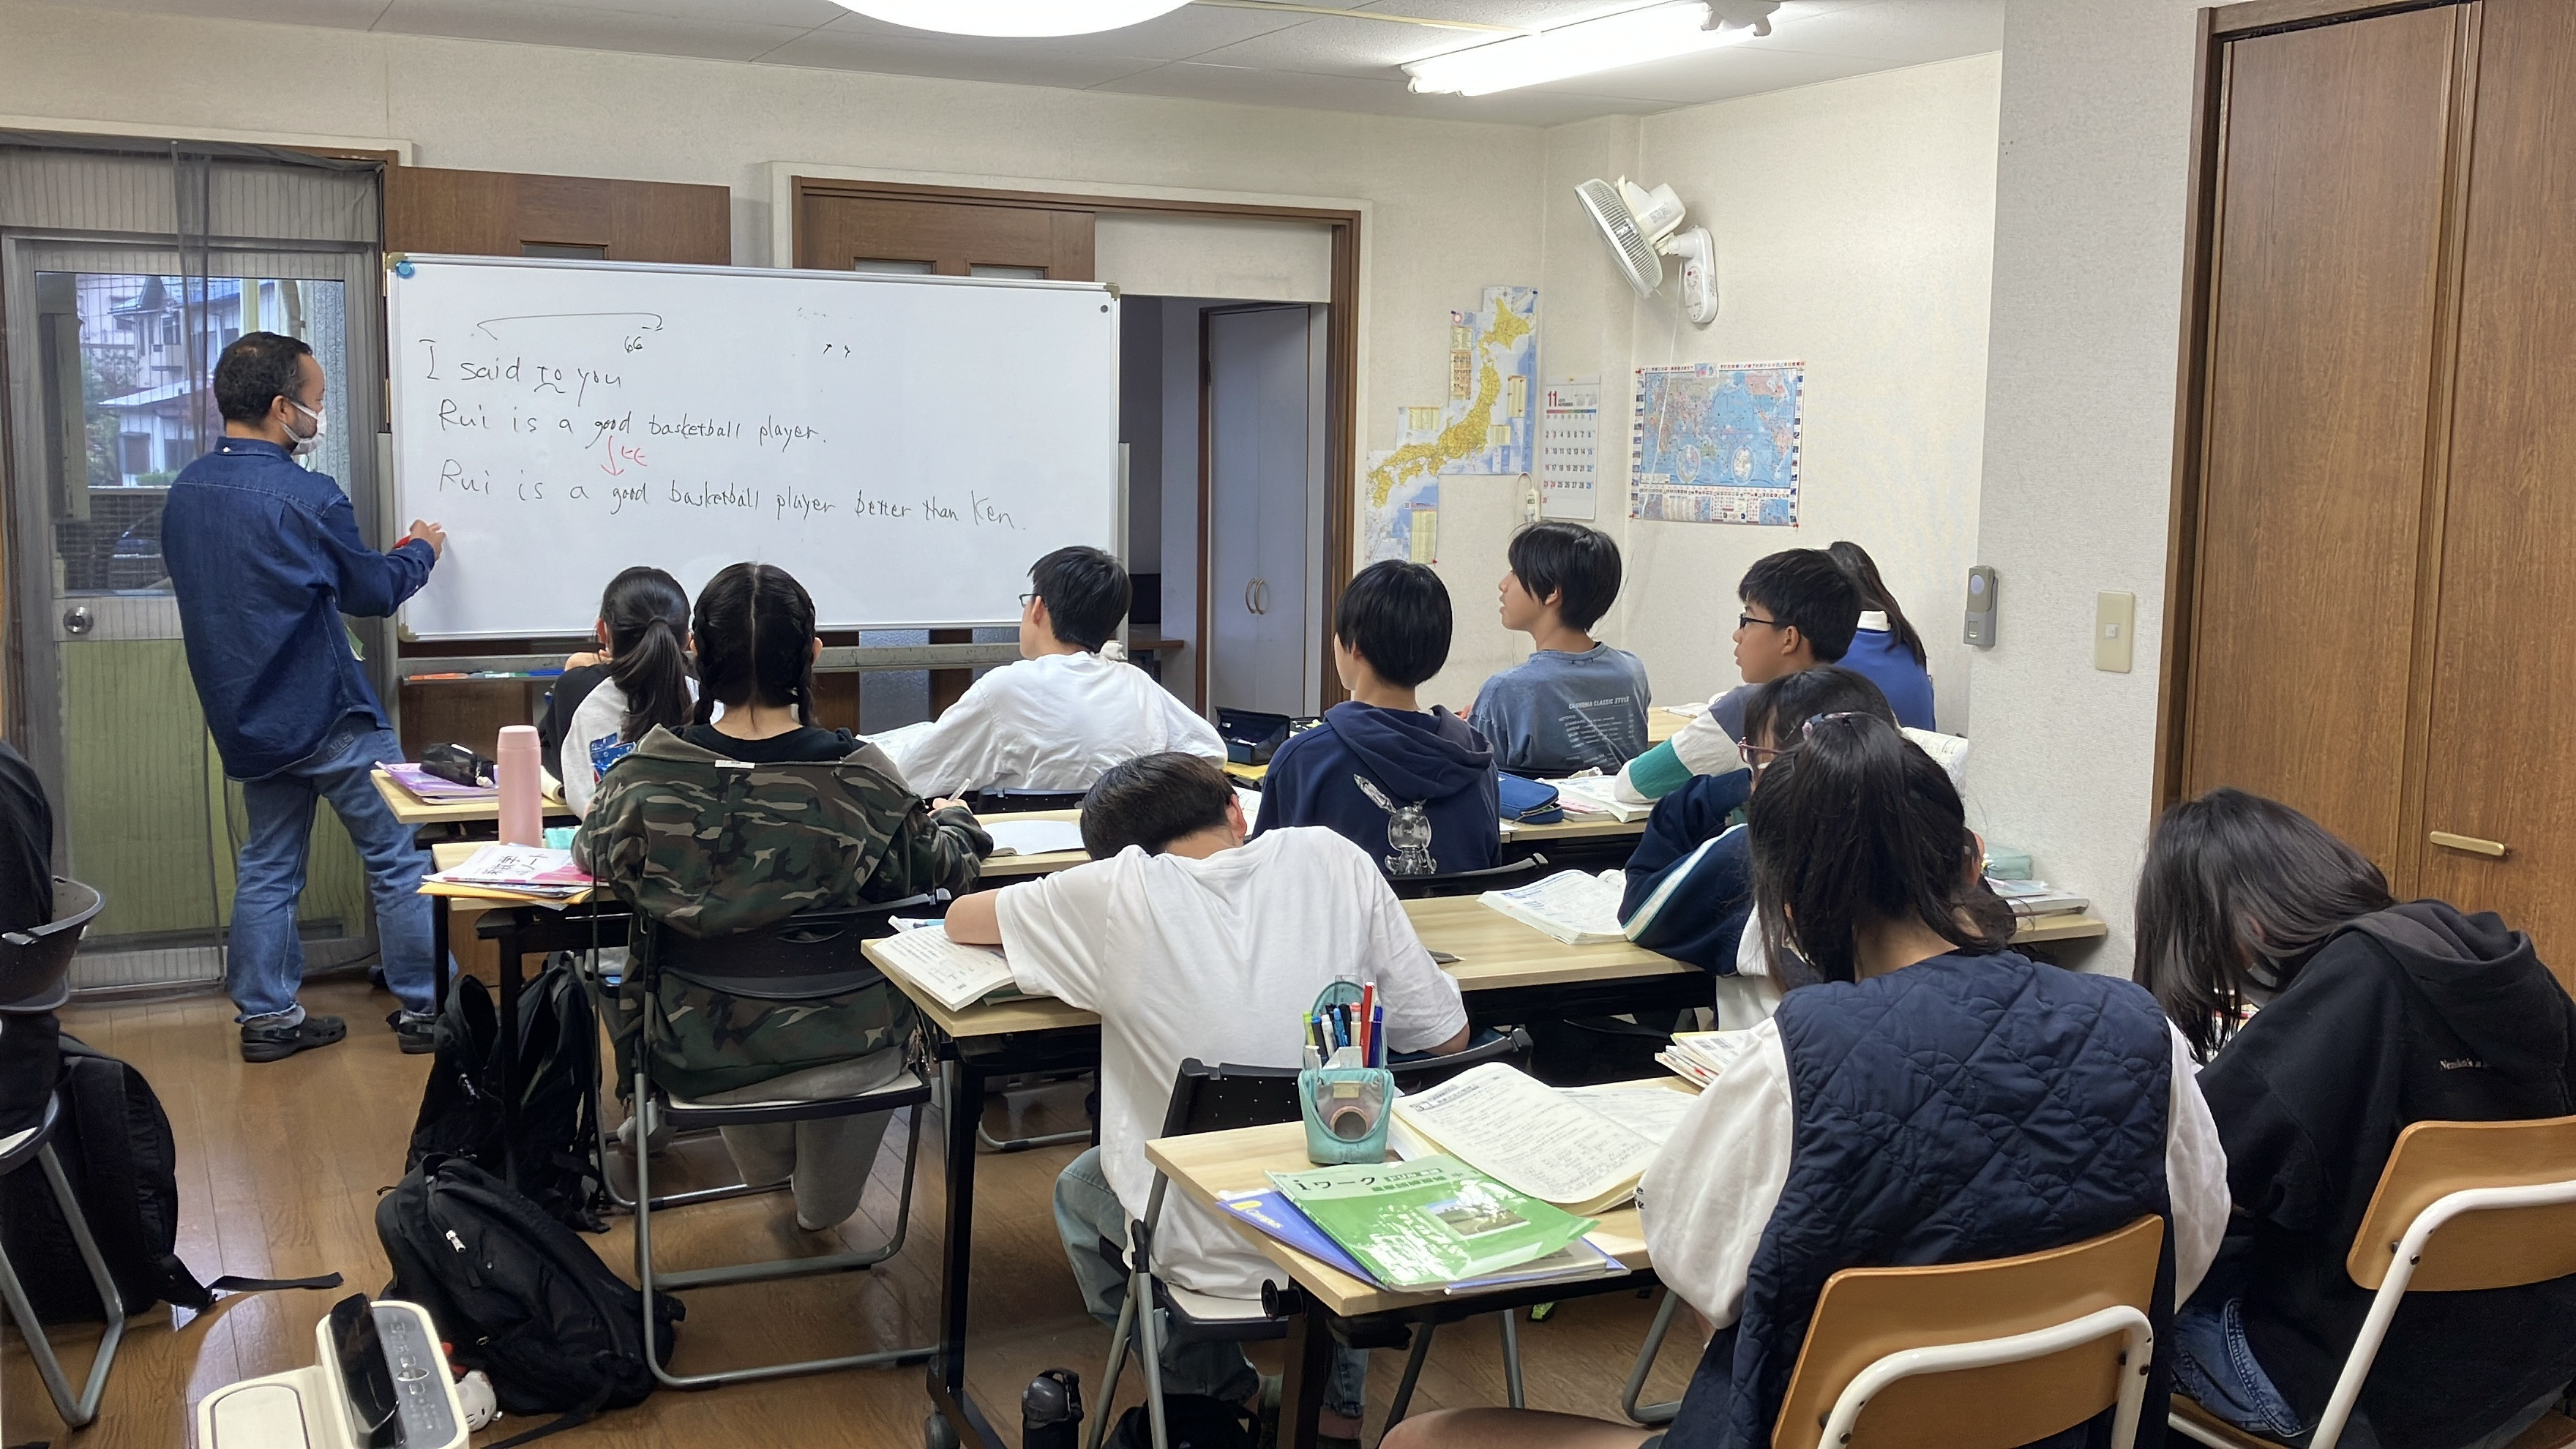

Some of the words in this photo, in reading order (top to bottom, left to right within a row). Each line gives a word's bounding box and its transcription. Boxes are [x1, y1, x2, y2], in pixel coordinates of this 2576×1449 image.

[419, 338, 440, 381] I
[460, 356, 520, 382] said
[536, 366, 562, 384] to
[577, 368, 622, 407] you
[1547, 390, 1557, 407] 11
[438, 398, 490, 430] Rui
[512, 406, 537, 433] is
[558, 418, 574, 433] a
[585, 411, 632, 449] good
[648, 413, 741, 439] basketball
[759, 414, 826, 453] player.
[439, 458, 490, 495] Rui
[517, 469, 544, 501] is
[569, 484, 590, 500] a
[610, 482, 650, 515] good
[670, 479, 759, 510] basketball
[776, 486, 836, 520] player
[921, 495, 959, 522] than
